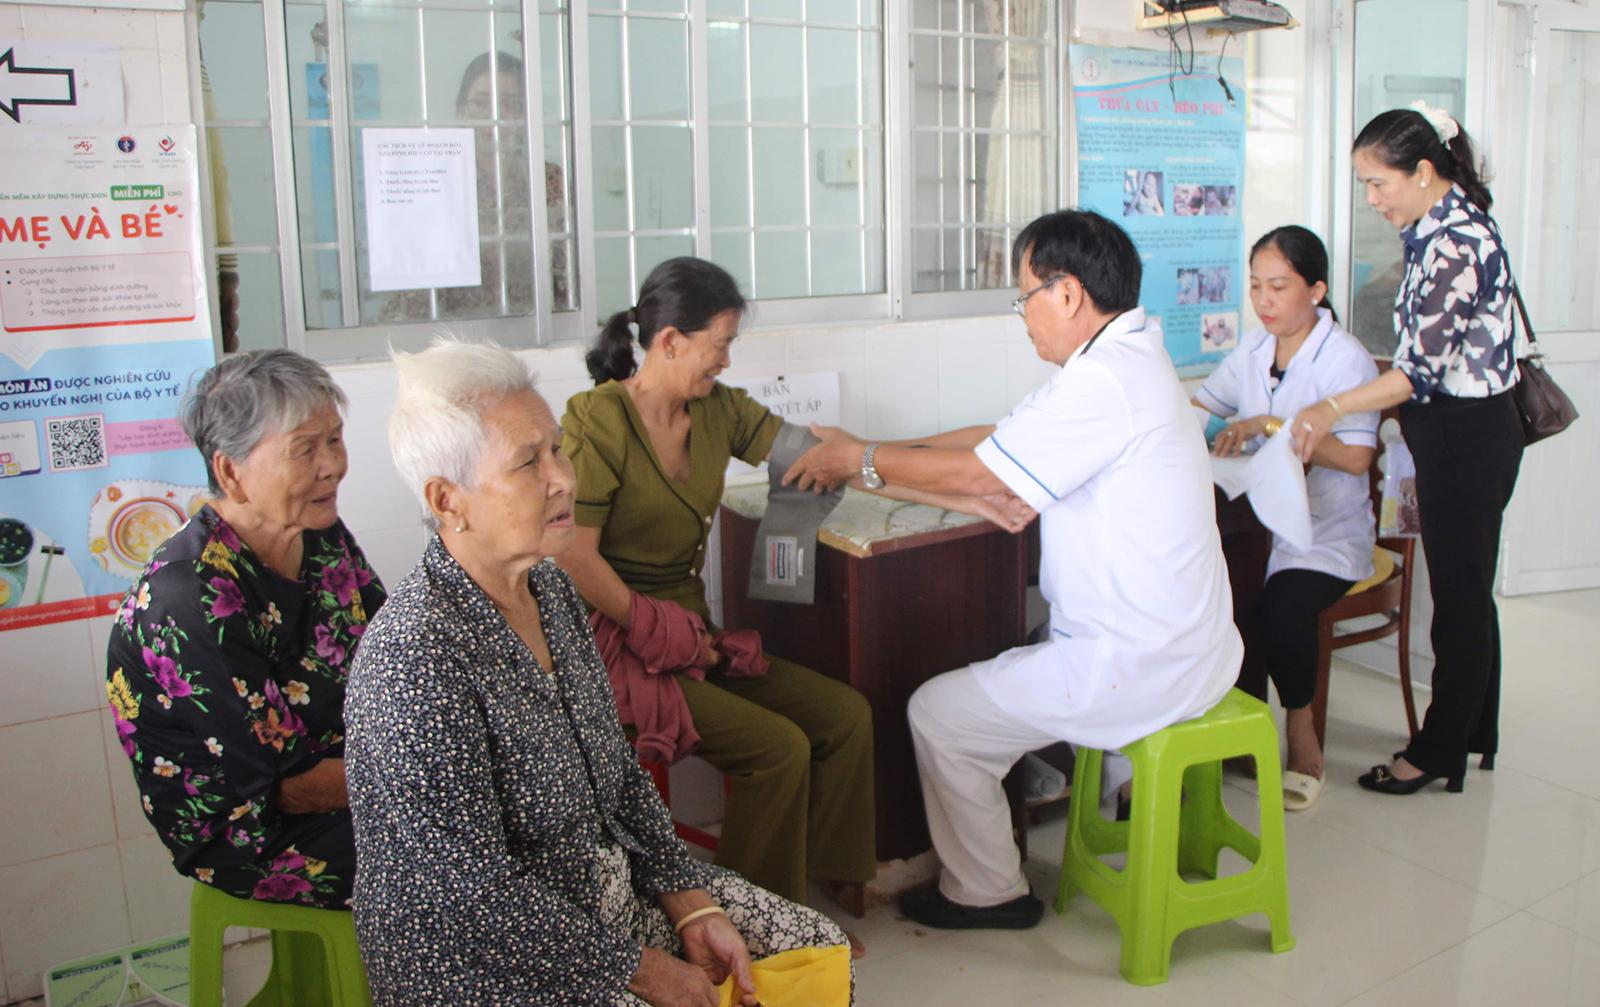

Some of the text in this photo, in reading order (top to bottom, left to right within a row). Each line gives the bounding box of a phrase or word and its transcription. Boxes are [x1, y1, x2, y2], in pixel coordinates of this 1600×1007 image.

[114, 185, 141, 198] MIỄN
[143, 187, 162, 197] PHÍ
[0, 204, 164, 249] MẸ VÀ BÉ
[28, 379, 49, 392] ĂN
[54, 376, 92, 390] ĐƯỢC
[94, 372, 142, 386] NGHIÊN
[145, 370, 172, 382] CỨU
[13, 392, 67, 410] KHUYẾN
[71, 394, 103, 405] NGHỊ
[106, 387, 132, 402] CỦA
[135, 388, 152, 401] BỘ
[154, 389, 163, 398] Y
[166, 384, 182, 397] TẾ
